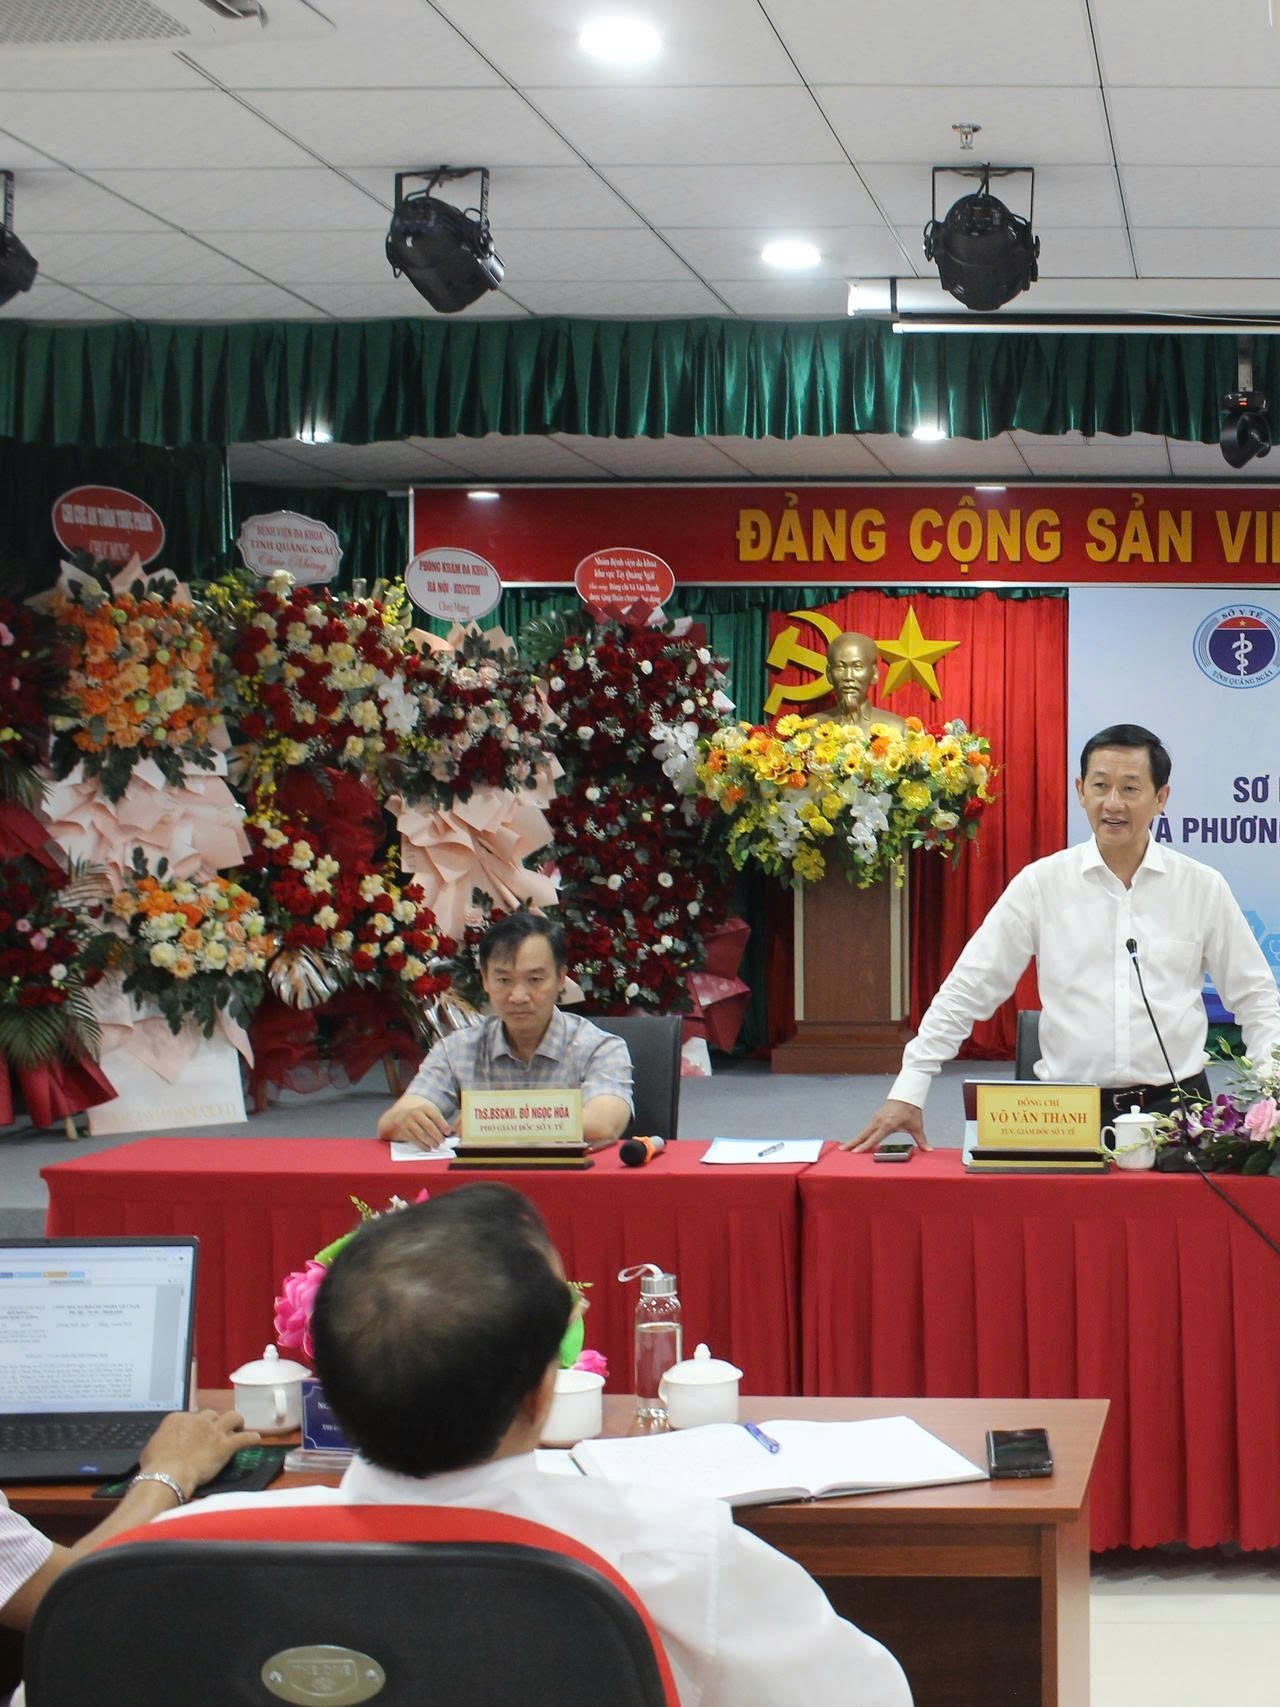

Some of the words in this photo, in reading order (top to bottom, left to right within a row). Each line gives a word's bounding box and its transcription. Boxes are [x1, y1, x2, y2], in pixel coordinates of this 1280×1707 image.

[736, 492, 886, 563] ĐẢNG
[910, 495, 1061, 573] CỘNG
[1086, 492, 1192, 564] SẢN
[1233, 775, 1270, 803] SƠ
[1017, 1097, 1042, 1106] ĐỒNG
[1044, 1098, 1060, 1106] CHÍ
[531, 1107, 552, 1121] NGỌC
[990, 1109, 1009, 1123] VÕ
[1011, 1110, 1038, 1123] VĂN
[1043, 1112, 1088, 1124] THANH
